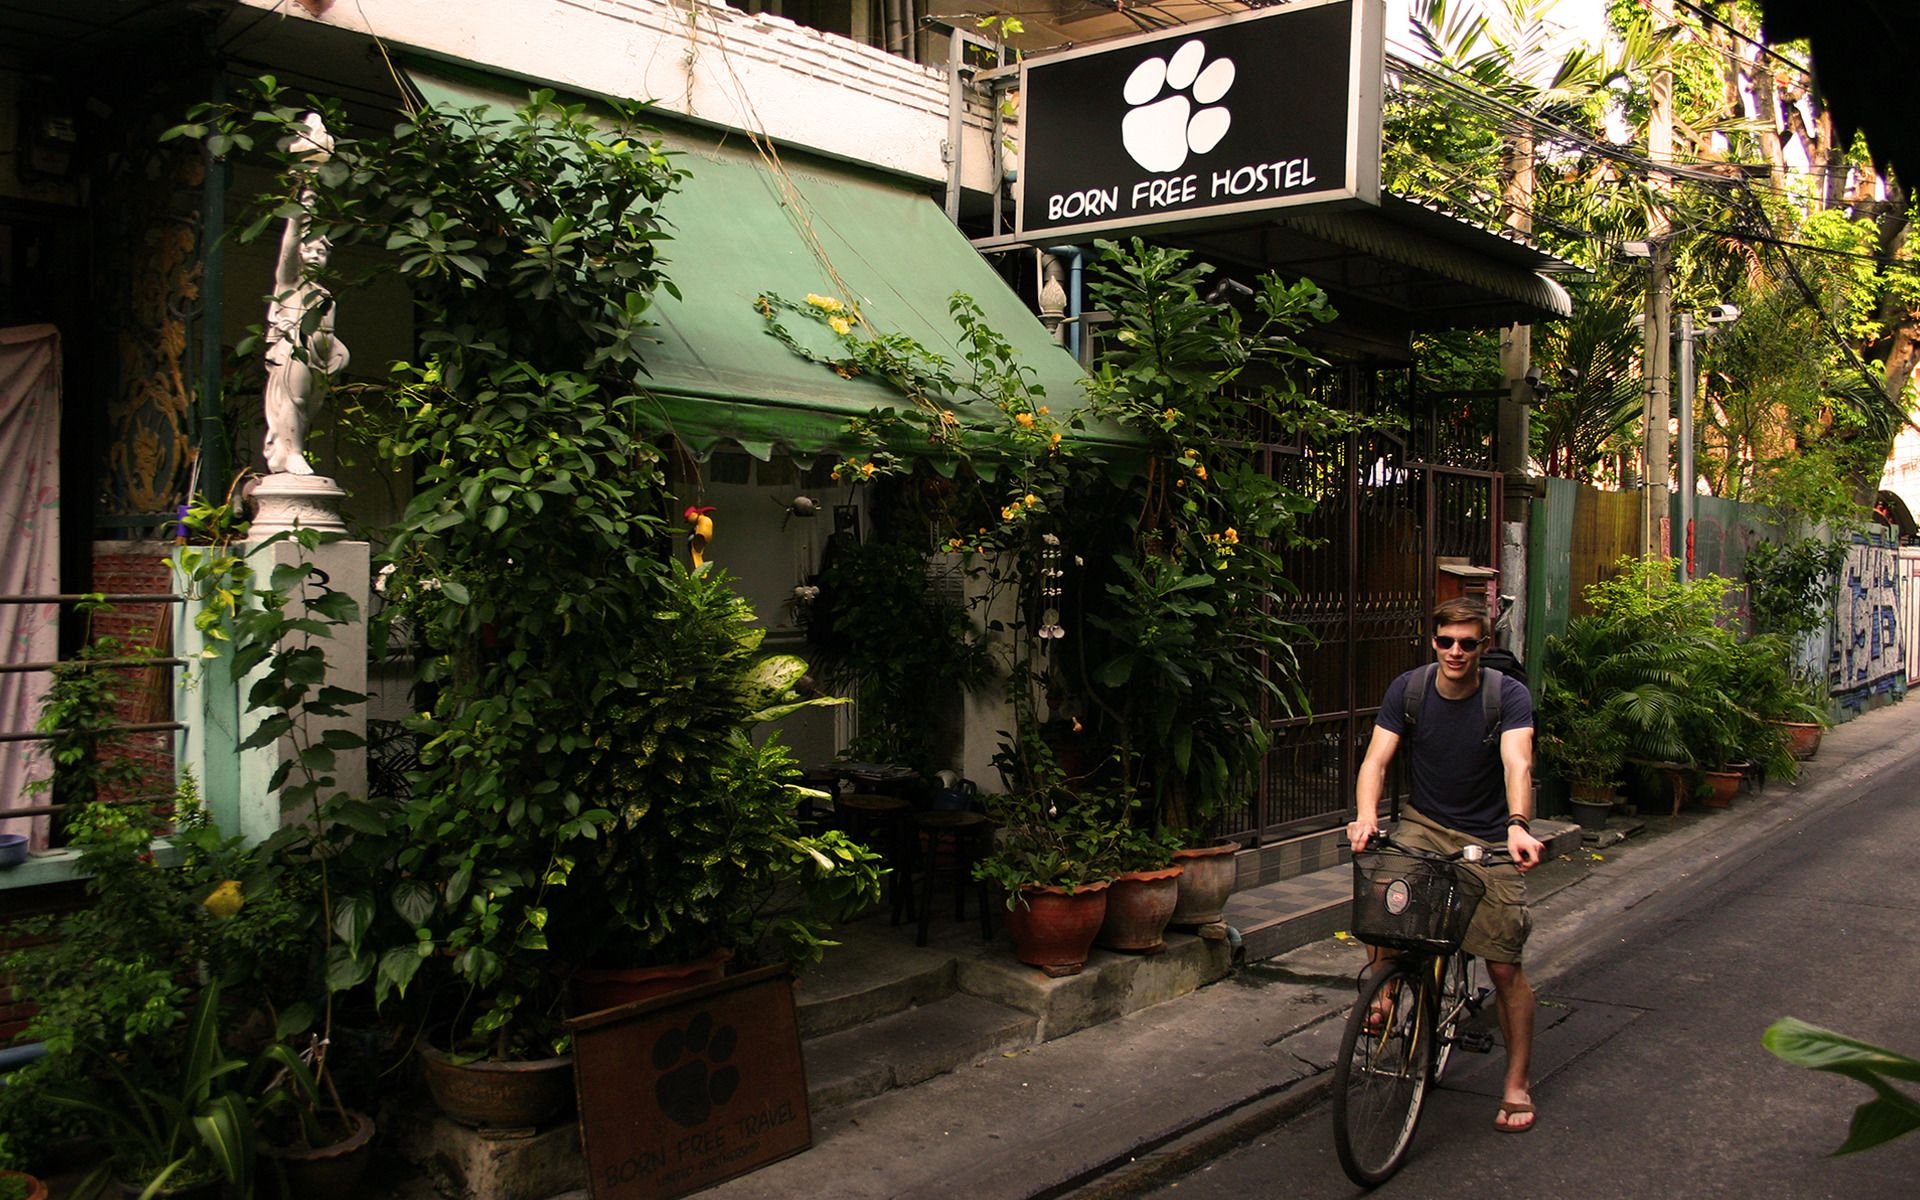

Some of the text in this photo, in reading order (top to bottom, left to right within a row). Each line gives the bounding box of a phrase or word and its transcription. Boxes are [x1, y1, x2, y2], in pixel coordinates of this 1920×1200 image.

[1048, 158, 1316, 221] BORN FREE HOSTEL
[604, 1100, 796, 1189] BORN FREE TRAVEL
